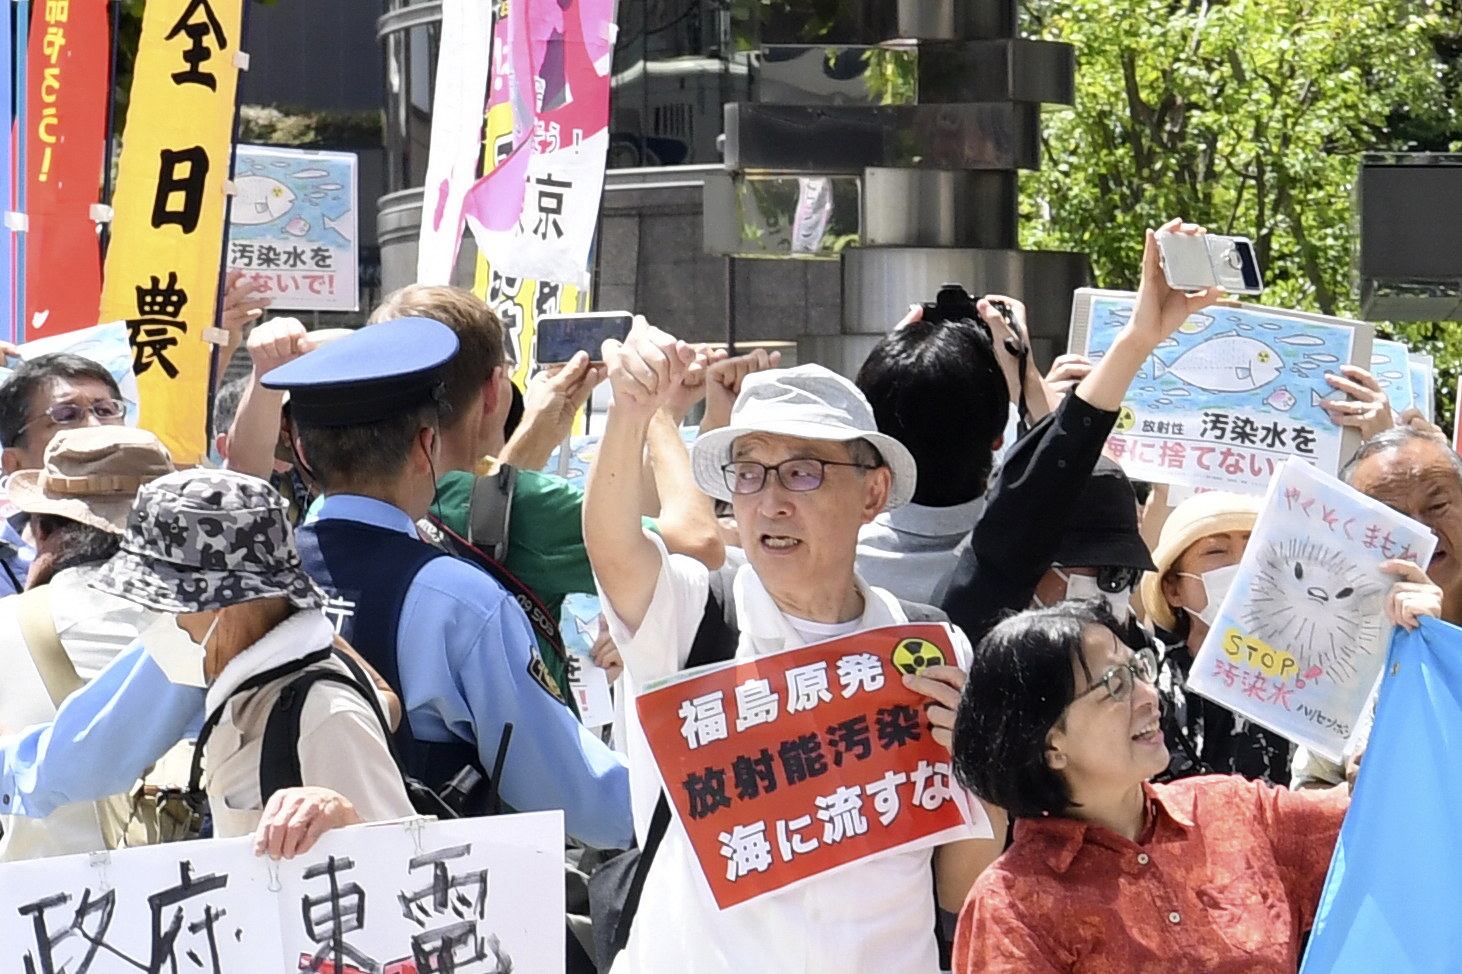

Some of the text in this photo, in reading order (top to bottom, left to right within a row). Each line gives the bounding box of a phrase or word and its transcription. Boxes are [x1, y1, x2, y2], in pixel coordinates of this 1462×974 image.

[127, 0, 228, 379] 全日農
[518, 172, 573, 240] 京
[230, 243, 333, 268] 汚染水を
[1106, 436, 1275, 478] 海に捨てない
[1142, 411, 1318, 454] 放射性 汚染水を
[1225, 634, 1295, 676] STOP
[678, 652, 886, 750] 福島原発
[681, 703, 938, 821] 放射能汚染
